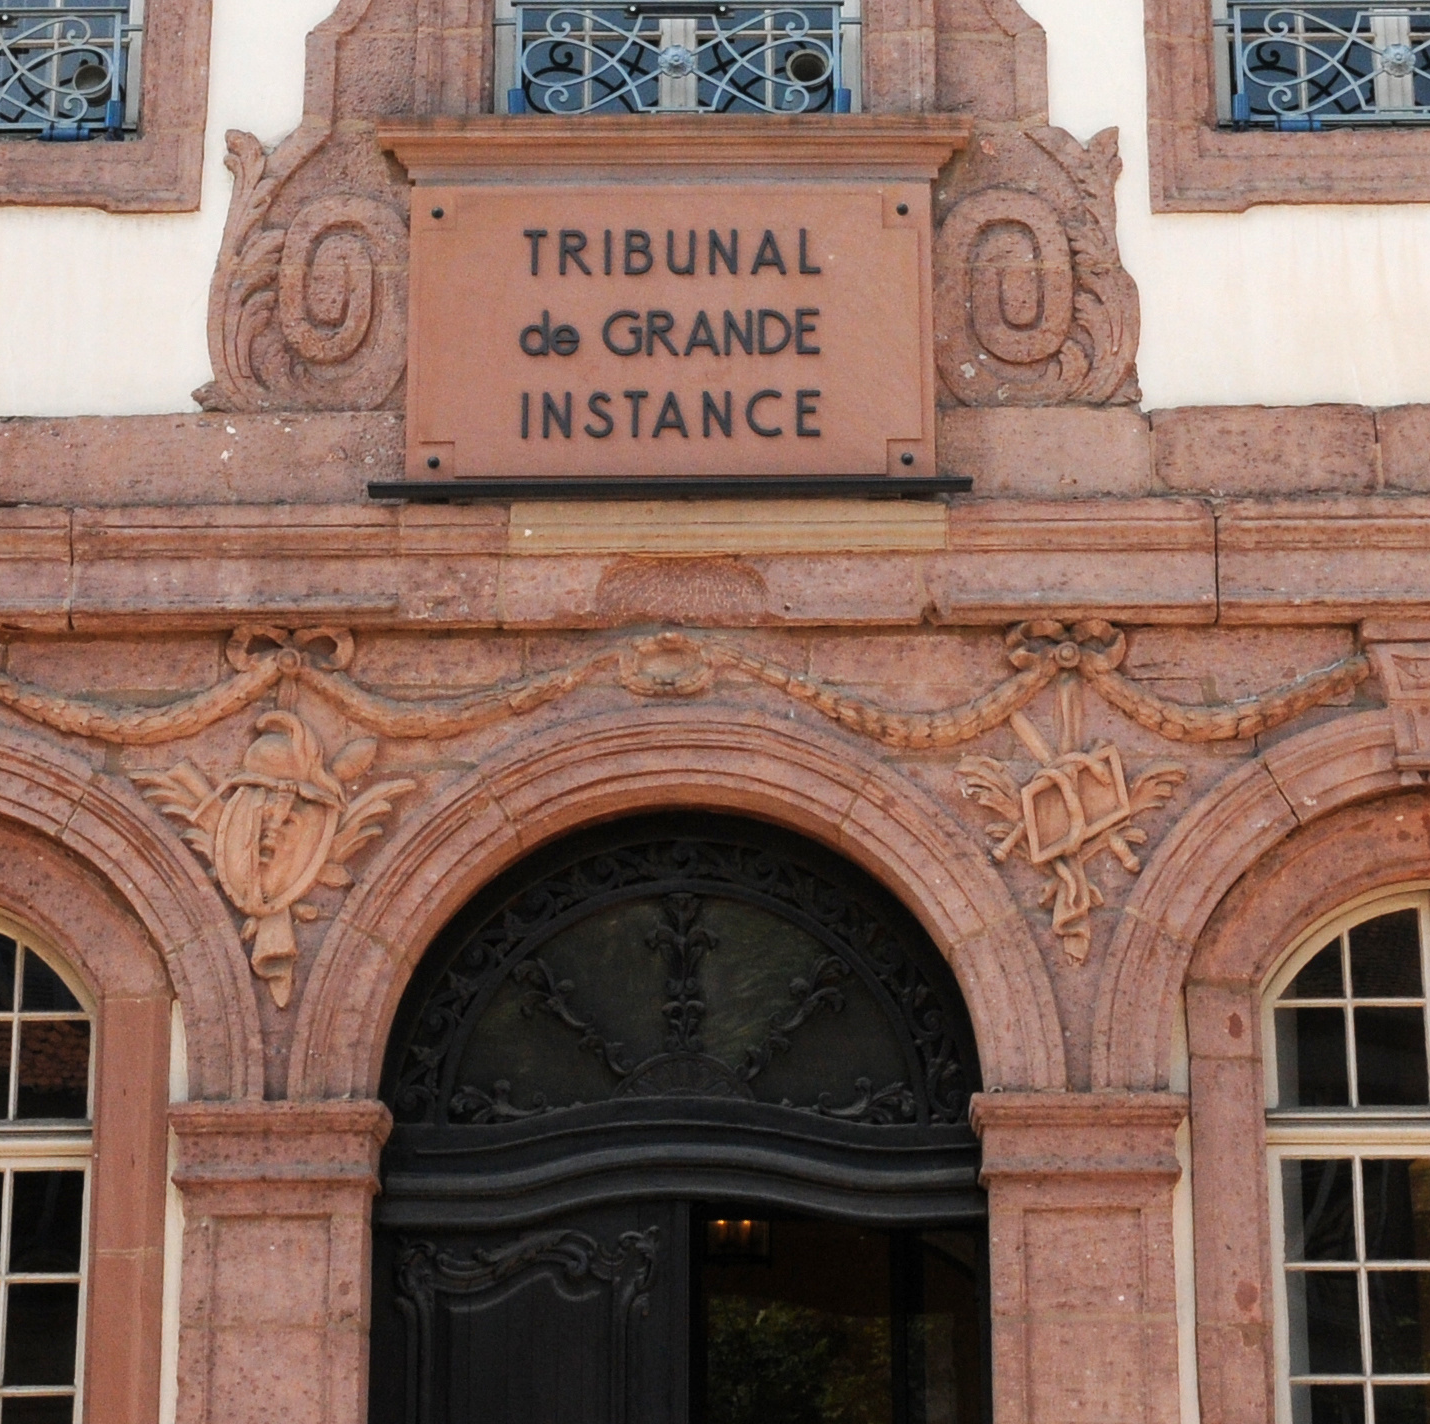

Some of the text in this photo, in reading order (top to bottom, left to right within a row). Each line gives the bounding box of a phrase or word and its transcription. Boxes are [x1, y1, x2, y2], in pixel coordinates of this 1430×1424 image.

[523, 229, 822, 276] TRIBUNAL
[519, 309, 821, 357] de GRANDE
[521, 390, 822, 439] INSTANCE
